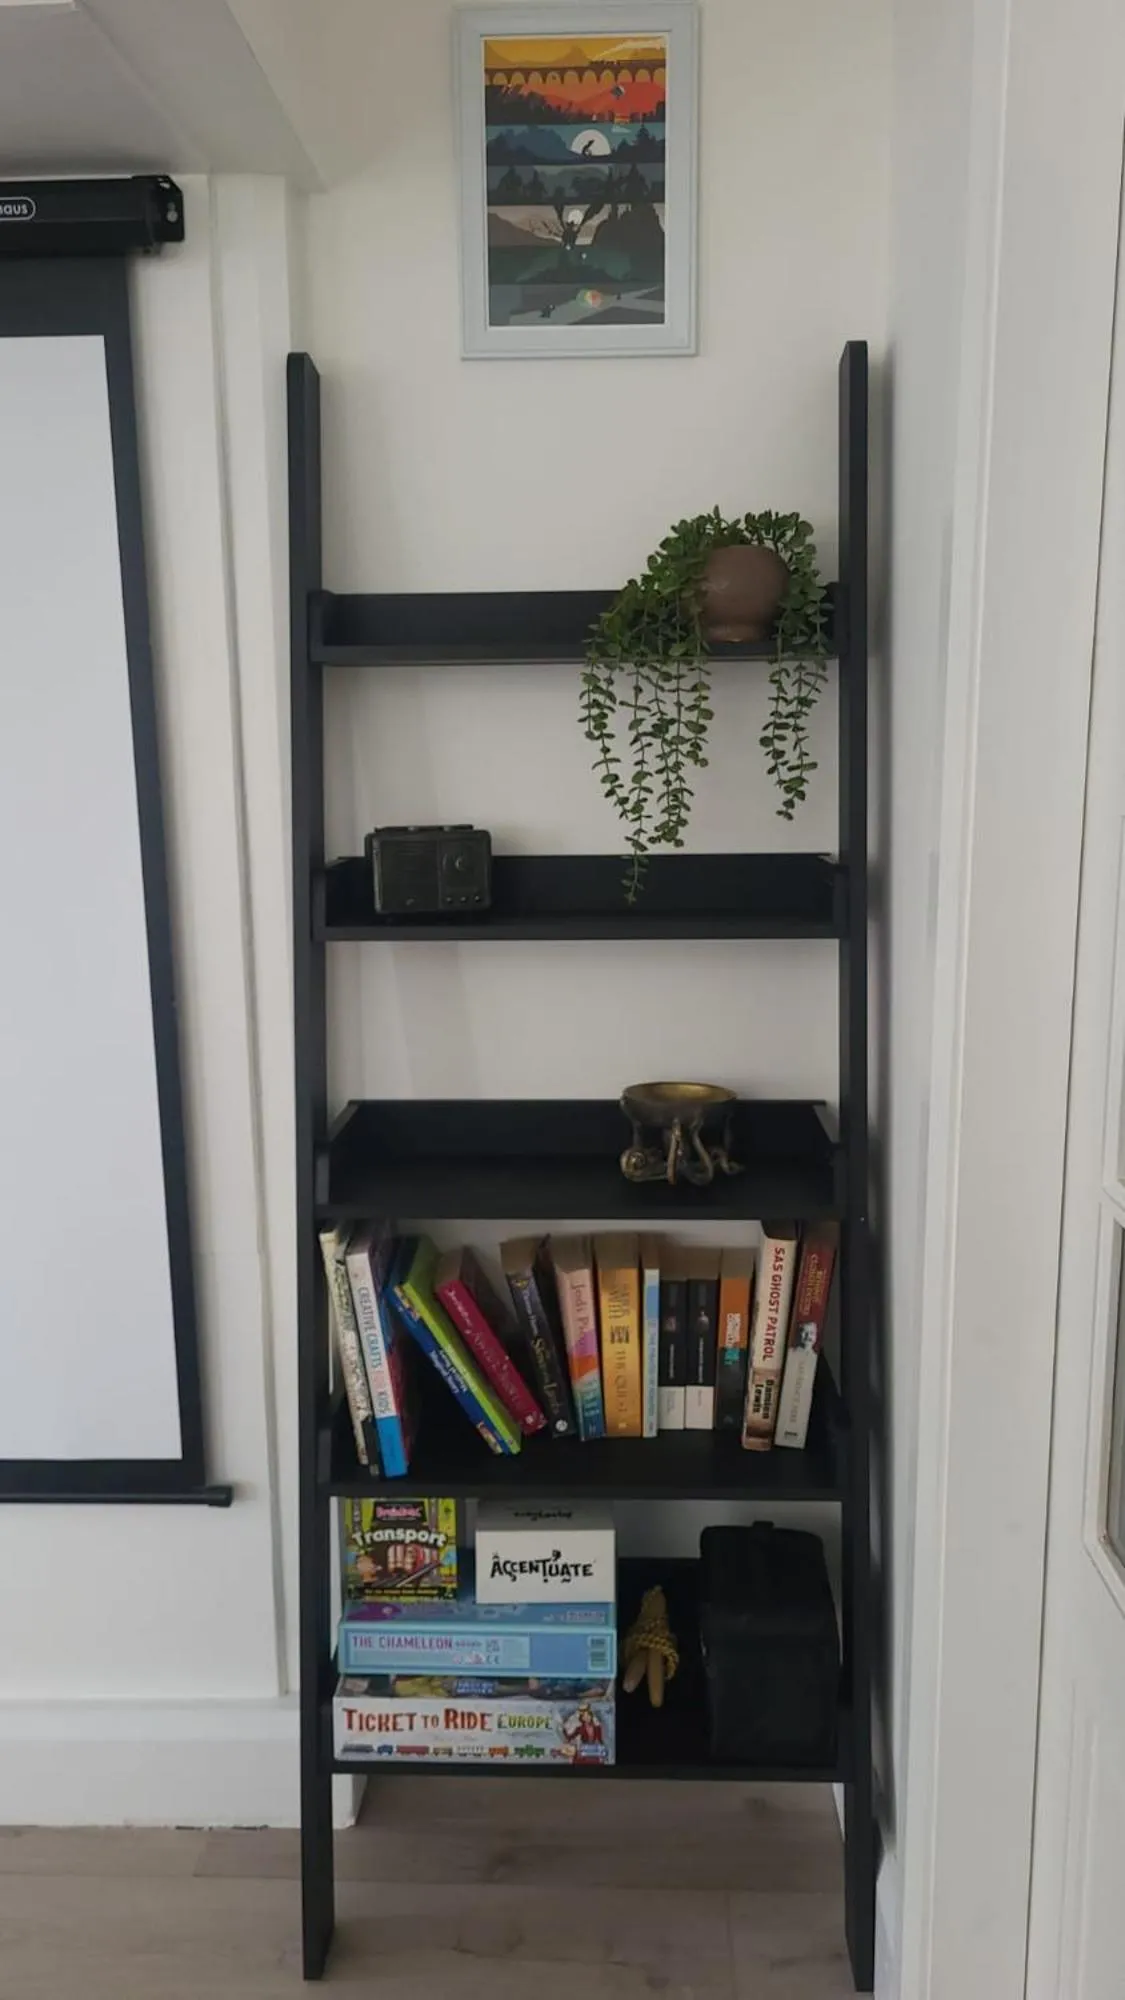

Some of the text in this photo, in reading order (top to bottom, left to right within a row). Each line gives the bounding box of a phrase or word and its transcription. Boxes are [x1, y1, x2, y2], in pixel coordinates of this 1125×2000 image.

[762, 1247, 786, 1362] SAS GHOST PATROL
[352, 1528, 447, 1548] Transport
[352, 1635, 372, 1649] THE
[378, 1634, 454, 1651] CHAMELEON
[342, 1707, 553, 1733] TICKET TO RIDE EUROPE
